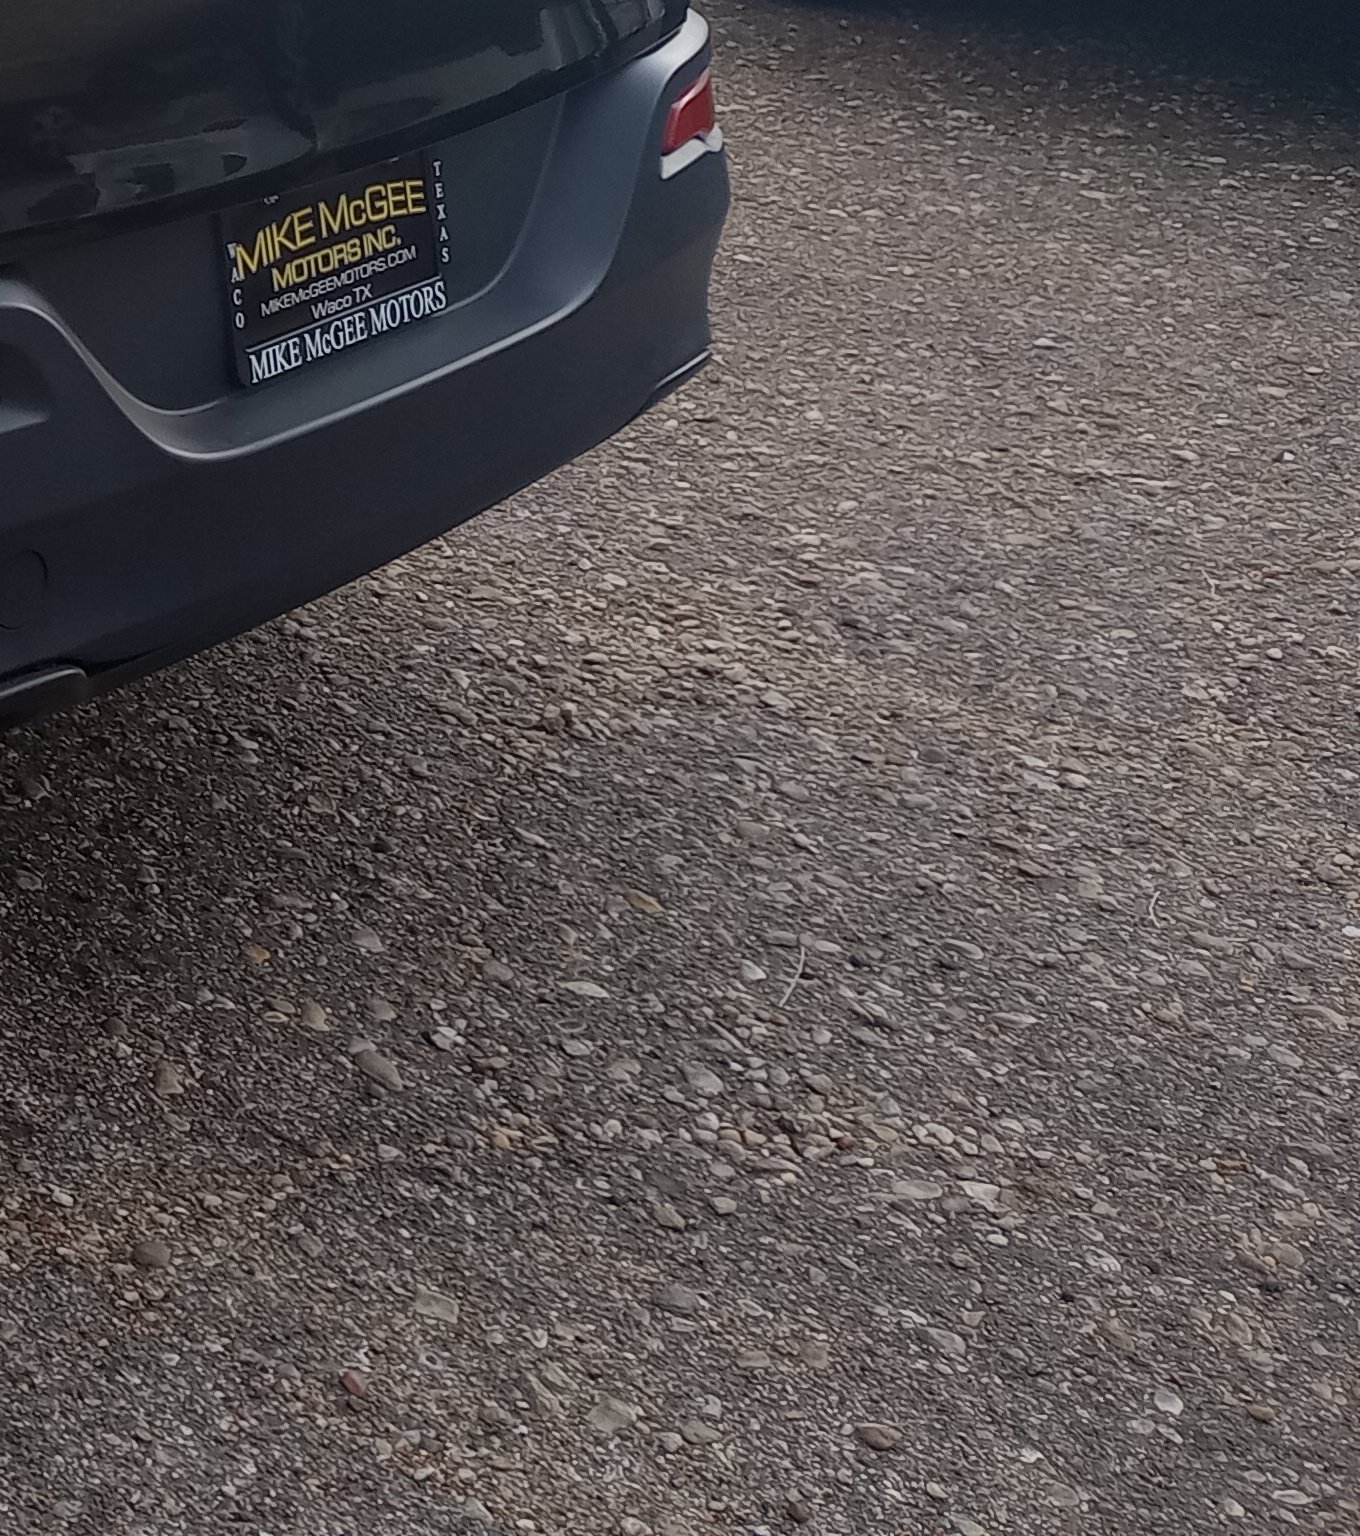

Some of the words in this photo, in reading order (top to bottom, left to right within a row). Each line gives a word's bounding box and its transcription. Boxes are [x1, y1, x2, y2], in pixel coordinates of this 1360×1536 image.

[235, 206, 316, 280] MIKE
[318, 179, 427, 239] McGEE
[272, 238, 361, 292] MOTORS
[363, 225, 402, 257] INC.
[433, 160, 450, 264] TEXAS
[249, 337, 303, 384] MIKE
[304, 311, 368, 362] McGEE
[368, 281, 448, 336] MOTORS
[311, 295, 352, 320] Waco
[352, 283, 373, 304] TX
